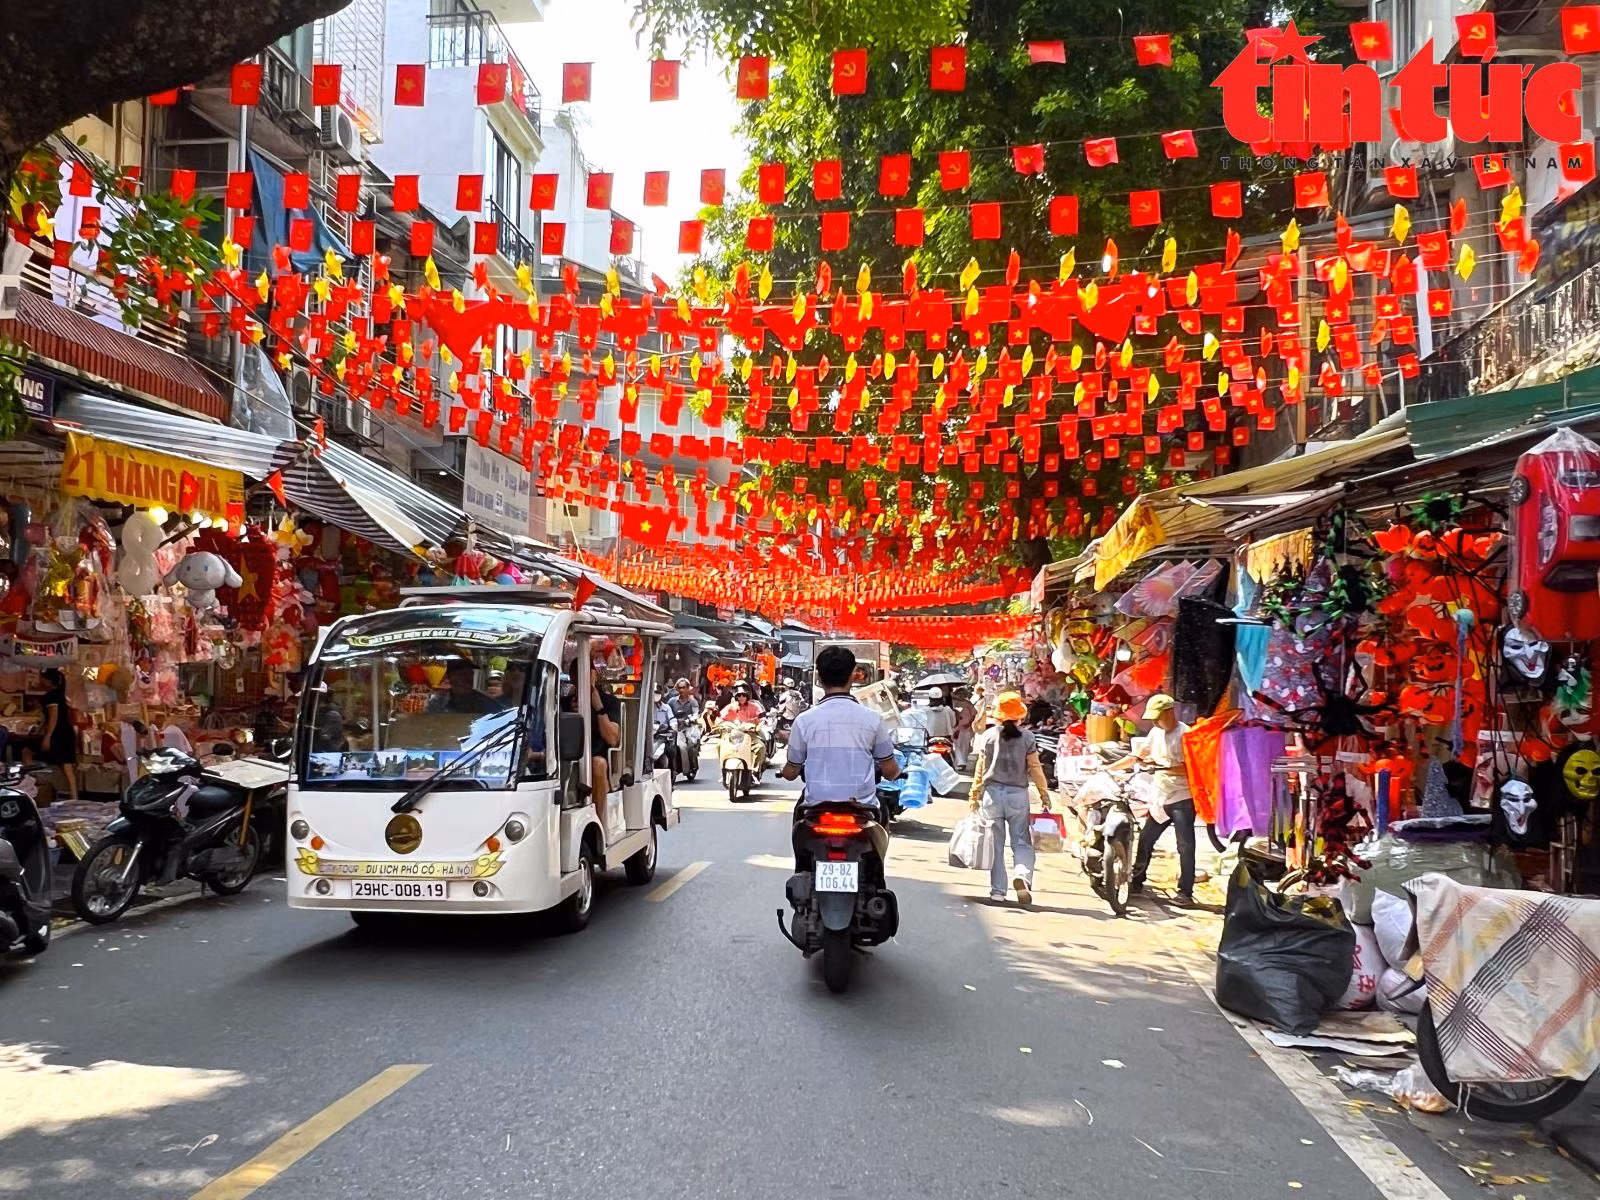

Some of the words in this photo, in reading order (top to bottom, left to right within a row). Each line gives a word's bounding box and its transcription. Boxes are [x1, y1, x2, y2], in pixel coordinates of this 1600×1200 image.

[106, 453, 178, 505] HÀNG
[355, 883, 444, 897] 29HC-008.19
[820, 876, 855, 890] 106.44
